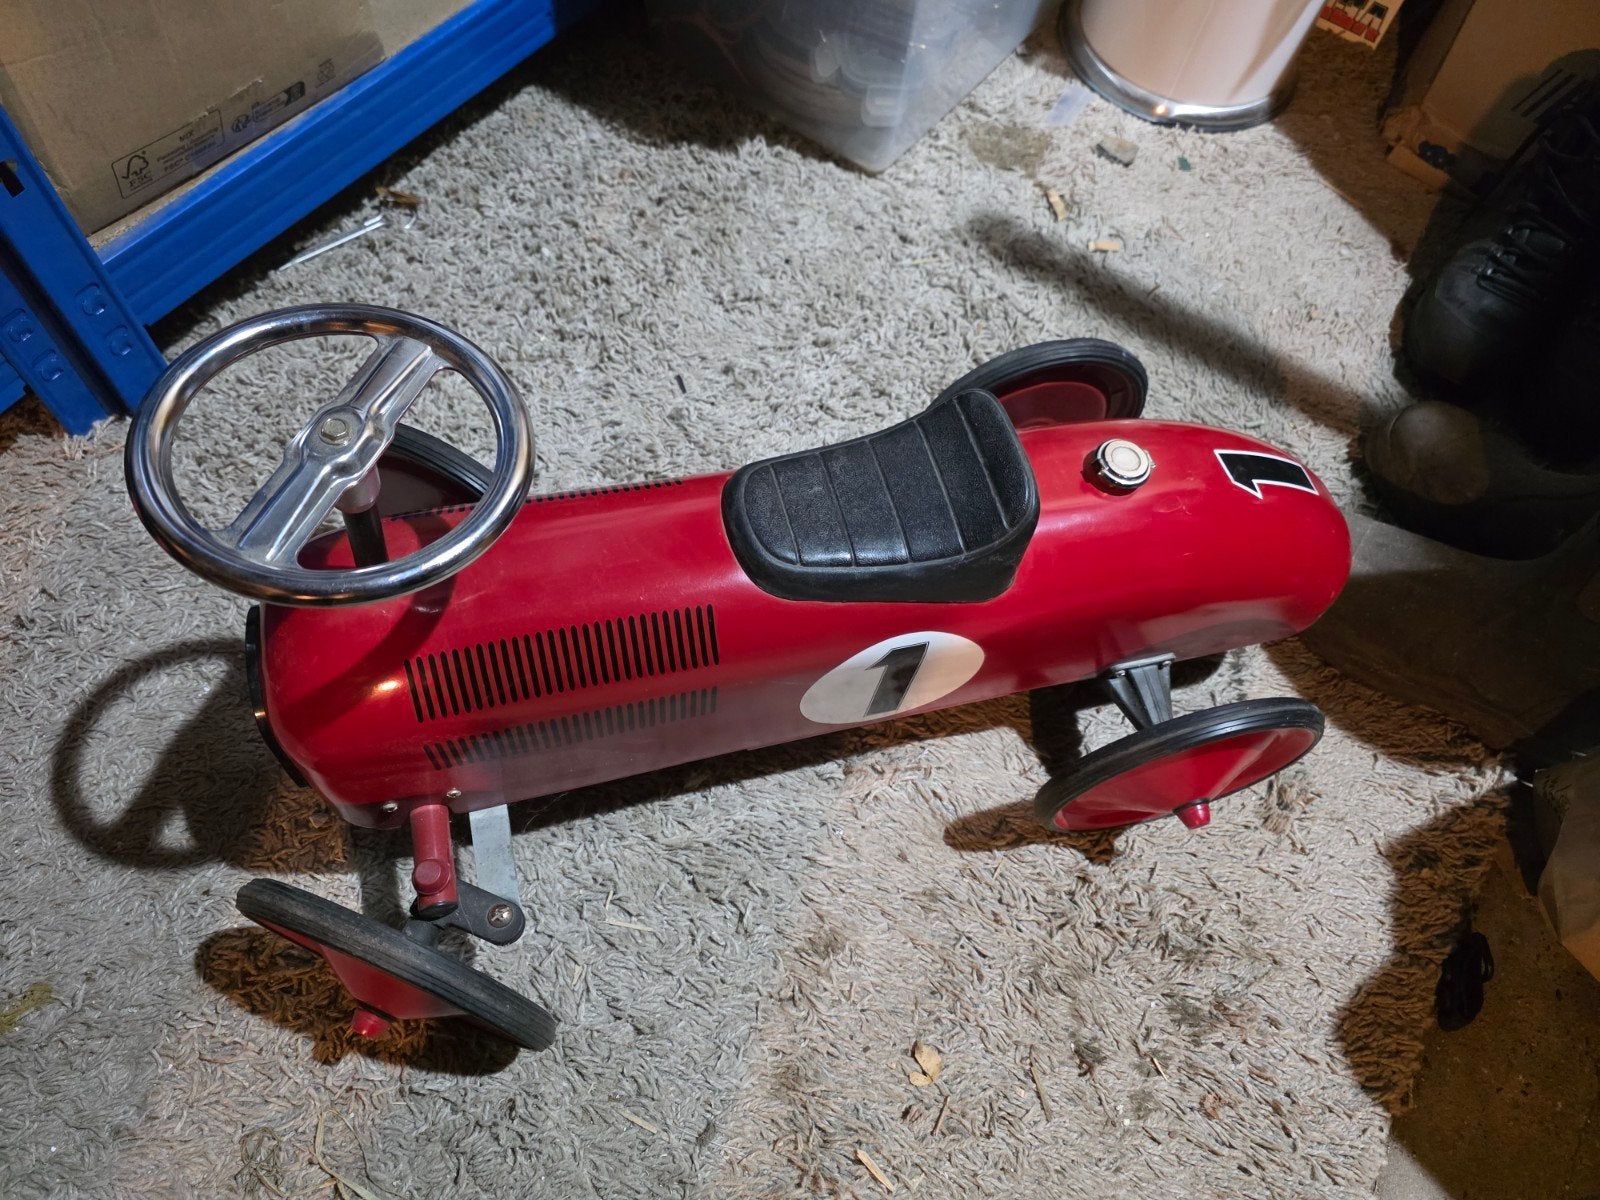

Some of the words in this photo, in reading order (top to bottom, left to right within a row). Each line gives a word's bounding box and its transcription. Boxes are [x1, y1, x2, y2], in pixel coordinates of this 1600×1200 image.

[129, 171, 152, 187] FSC
[1213, 448, 1319, 500] 1
[864, 641, 930, 718] 1
